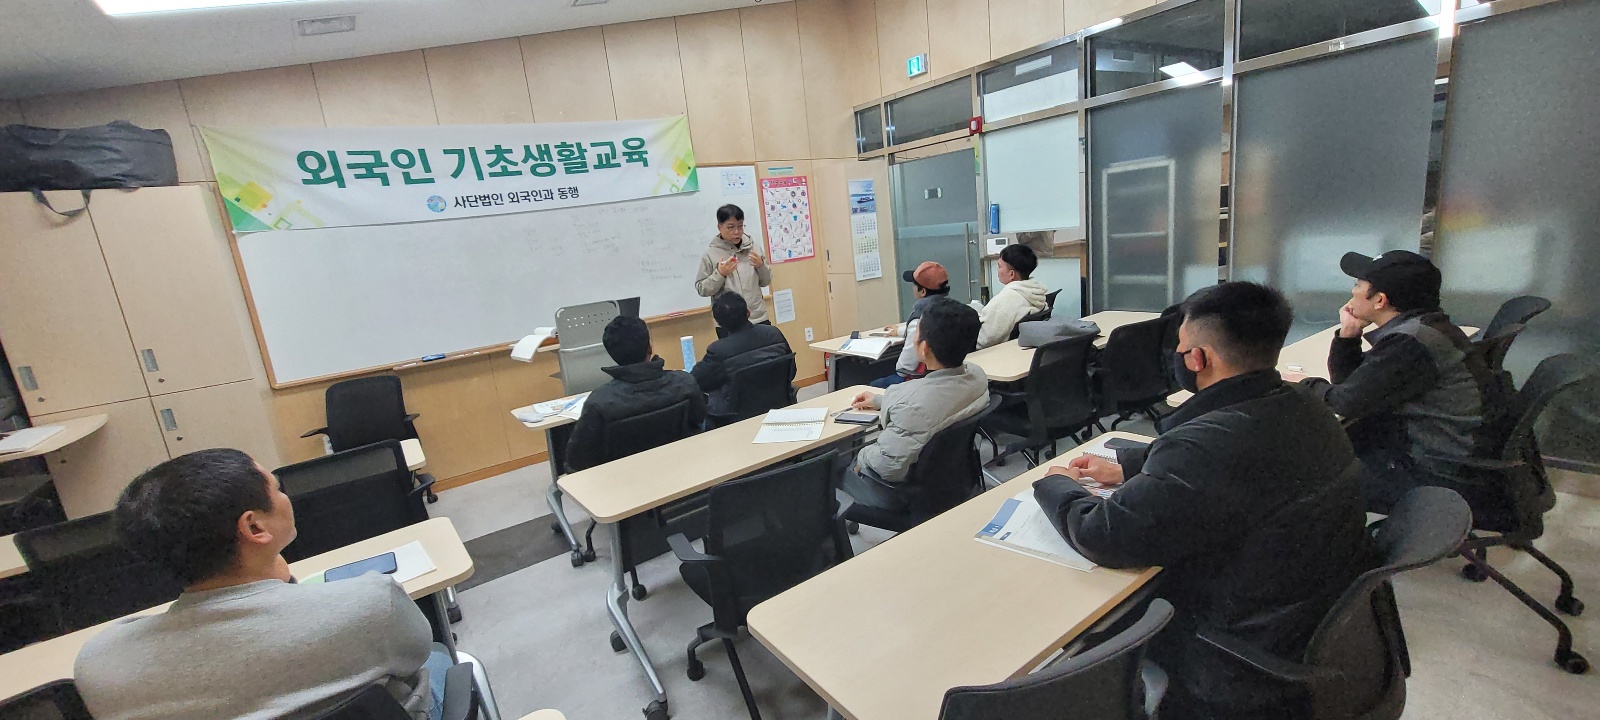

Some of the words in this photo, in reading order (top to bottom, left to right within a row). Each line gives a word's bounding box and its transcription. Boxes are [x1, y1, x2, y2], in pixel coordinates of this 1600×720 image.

[296, 148, 436, 189] 외국인
[442, 137, 650, 182] 기초생활교육
[453, 192, 505, 208] 사단법인
[507, 188, 555, 204] 외국인과
[557, 186, 580, 200] 동행
